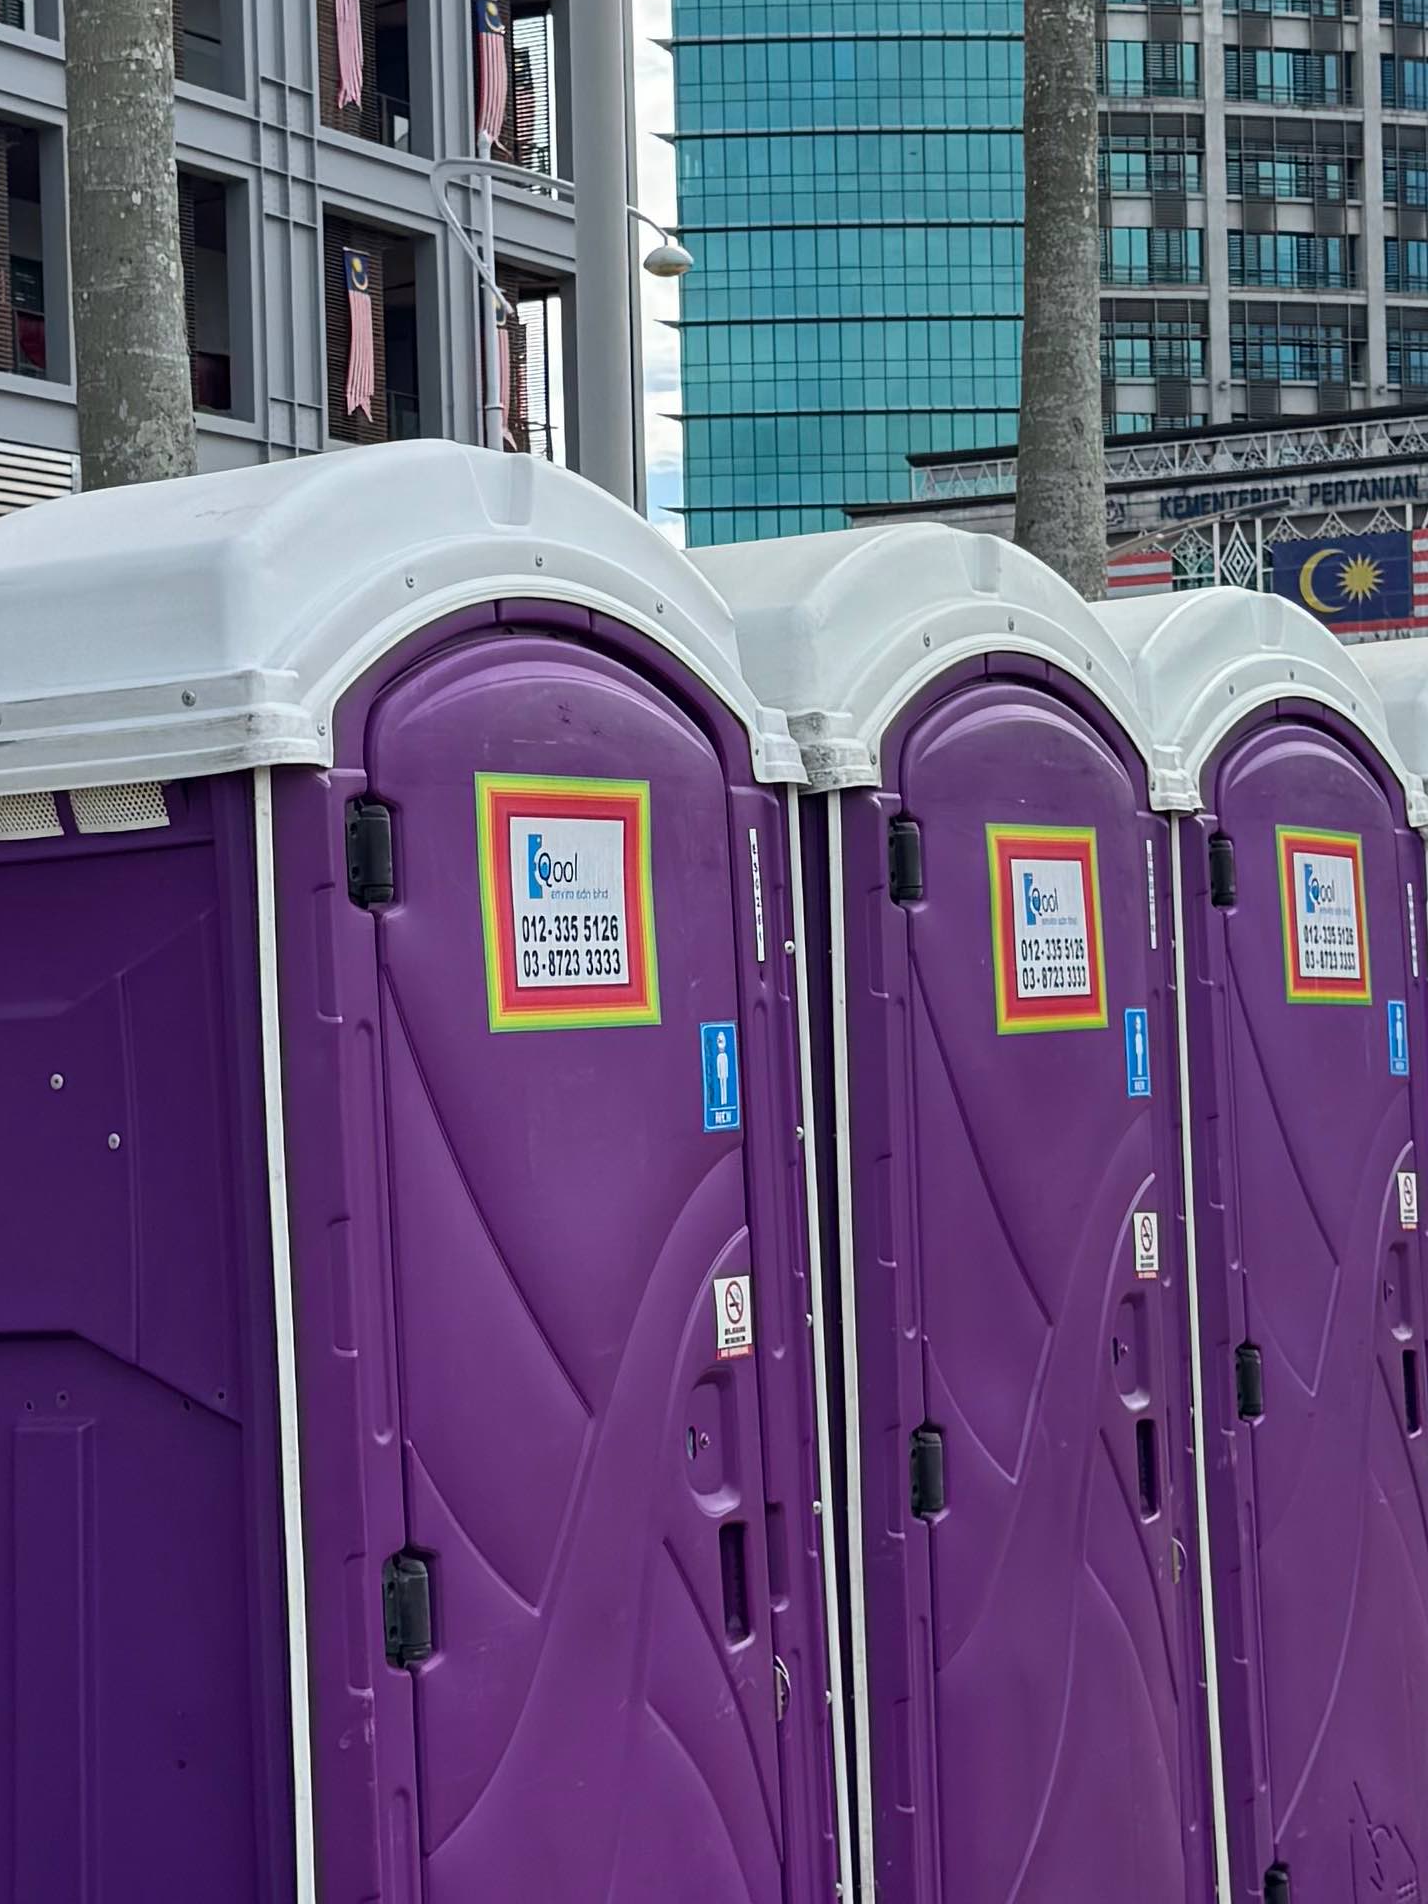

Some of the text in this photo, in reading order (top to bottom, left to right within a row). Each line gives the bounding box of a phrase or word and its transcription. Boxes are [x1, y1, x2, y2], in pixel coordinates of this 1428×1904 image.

[1309, 474, 1419, 506] PERTANIAN
[538, 852, 579, 888] Qool
[522, 915, 619, 943] 012-335 5126
[523, 948, 621, 977] 03-8723 3333
[1021, 938, 1062, 961] 012-335
[1022, 966, 1065, 990] 03-8723
